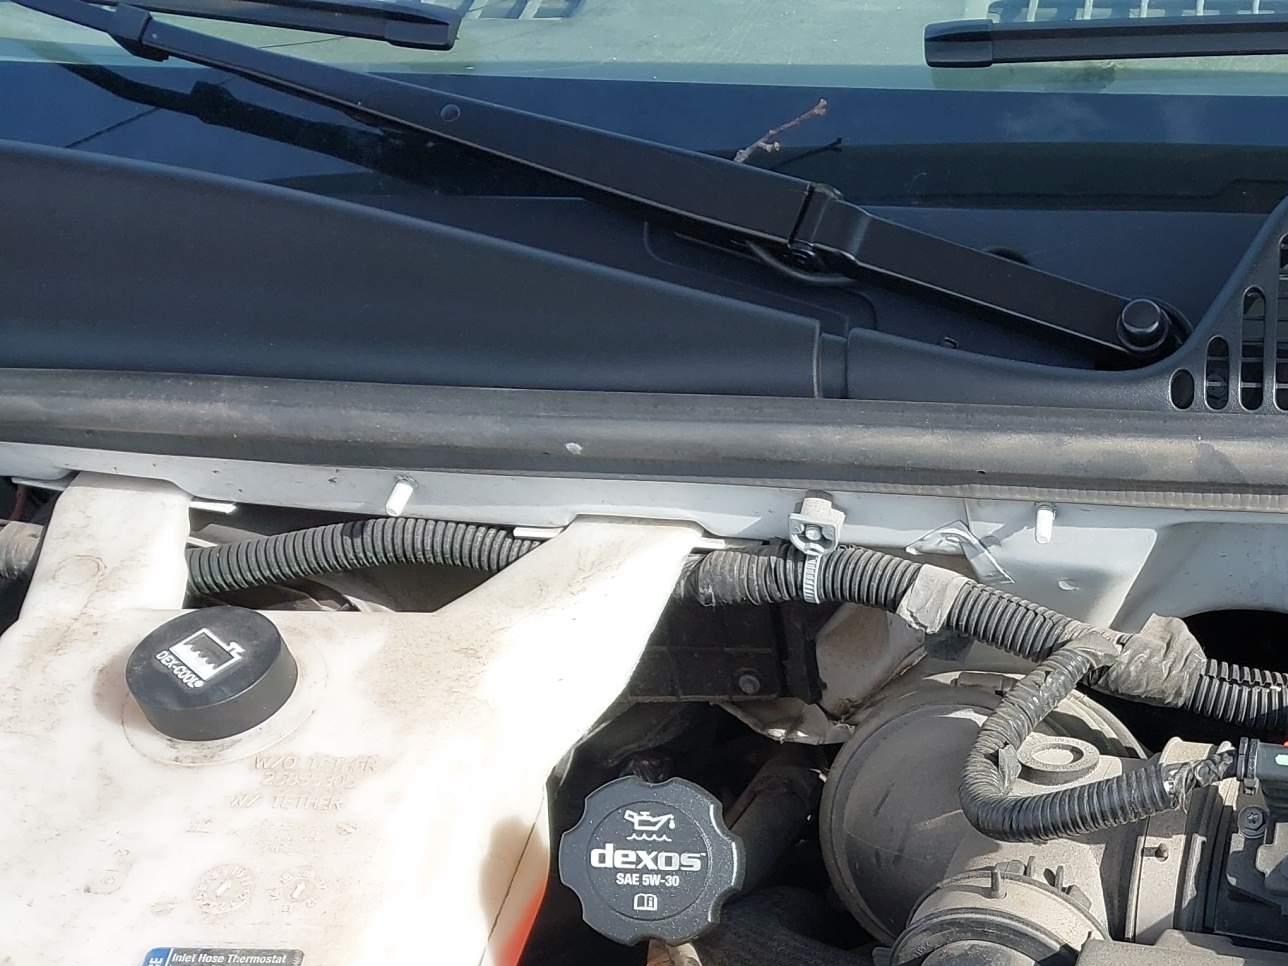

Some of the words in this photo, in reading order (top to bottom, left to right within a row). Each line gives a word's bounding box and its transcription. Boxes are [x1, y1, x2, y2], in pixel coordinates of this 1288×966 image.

[590, 843, 702, 872] dexos
[616, 873, 640, 886] SAE
[642, 873, 680, 887] 5W-30
[172, 953, 196, 963] Inlet
[197, 954, 225, 963] Hose
[227, 953, 286, 964] Thermostat
